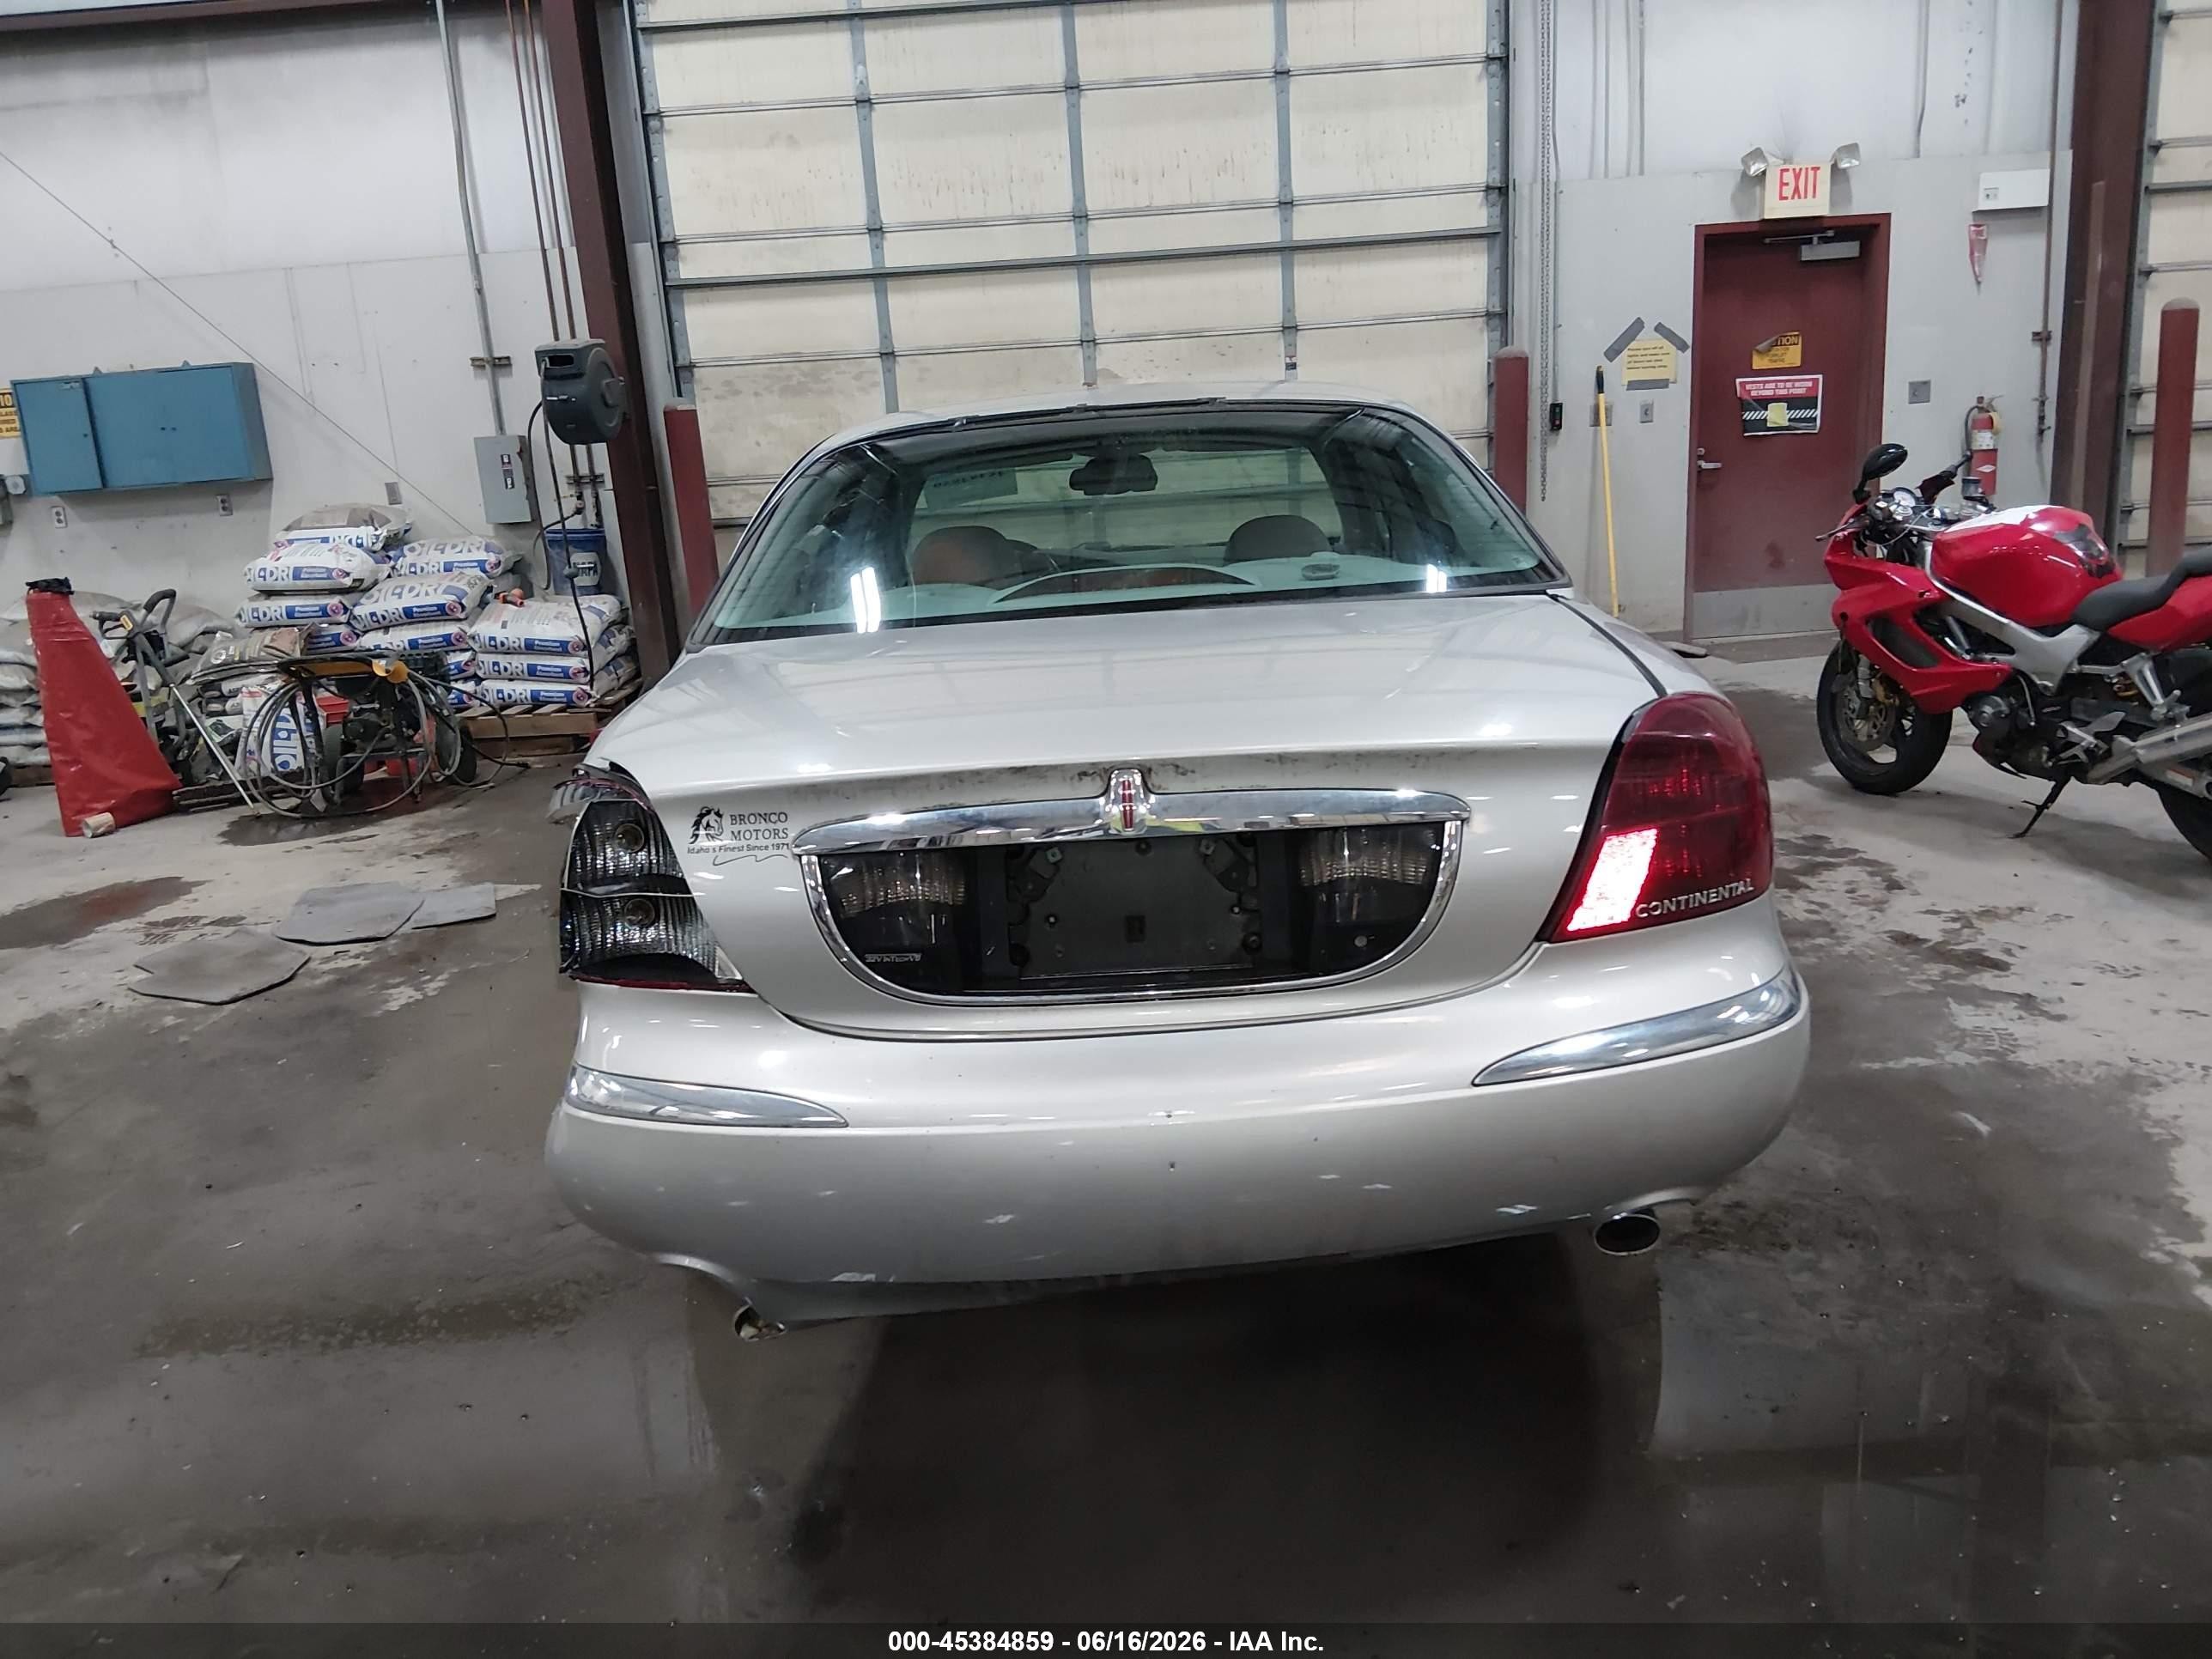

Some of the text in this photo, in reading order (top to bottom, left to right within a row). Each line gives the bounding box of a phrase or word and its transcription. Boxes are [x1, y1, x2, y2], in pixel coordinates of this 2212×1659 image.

[1778, 166, 1821, 201] EXIT
[730, 811, 787, 825] BRONCO
[730, 828, 789, 842] MOTORS
[687, 842, 790, 854] Idahos Finest Since 1971
[1635, 878, 1755, 918] CONTINENTAL
